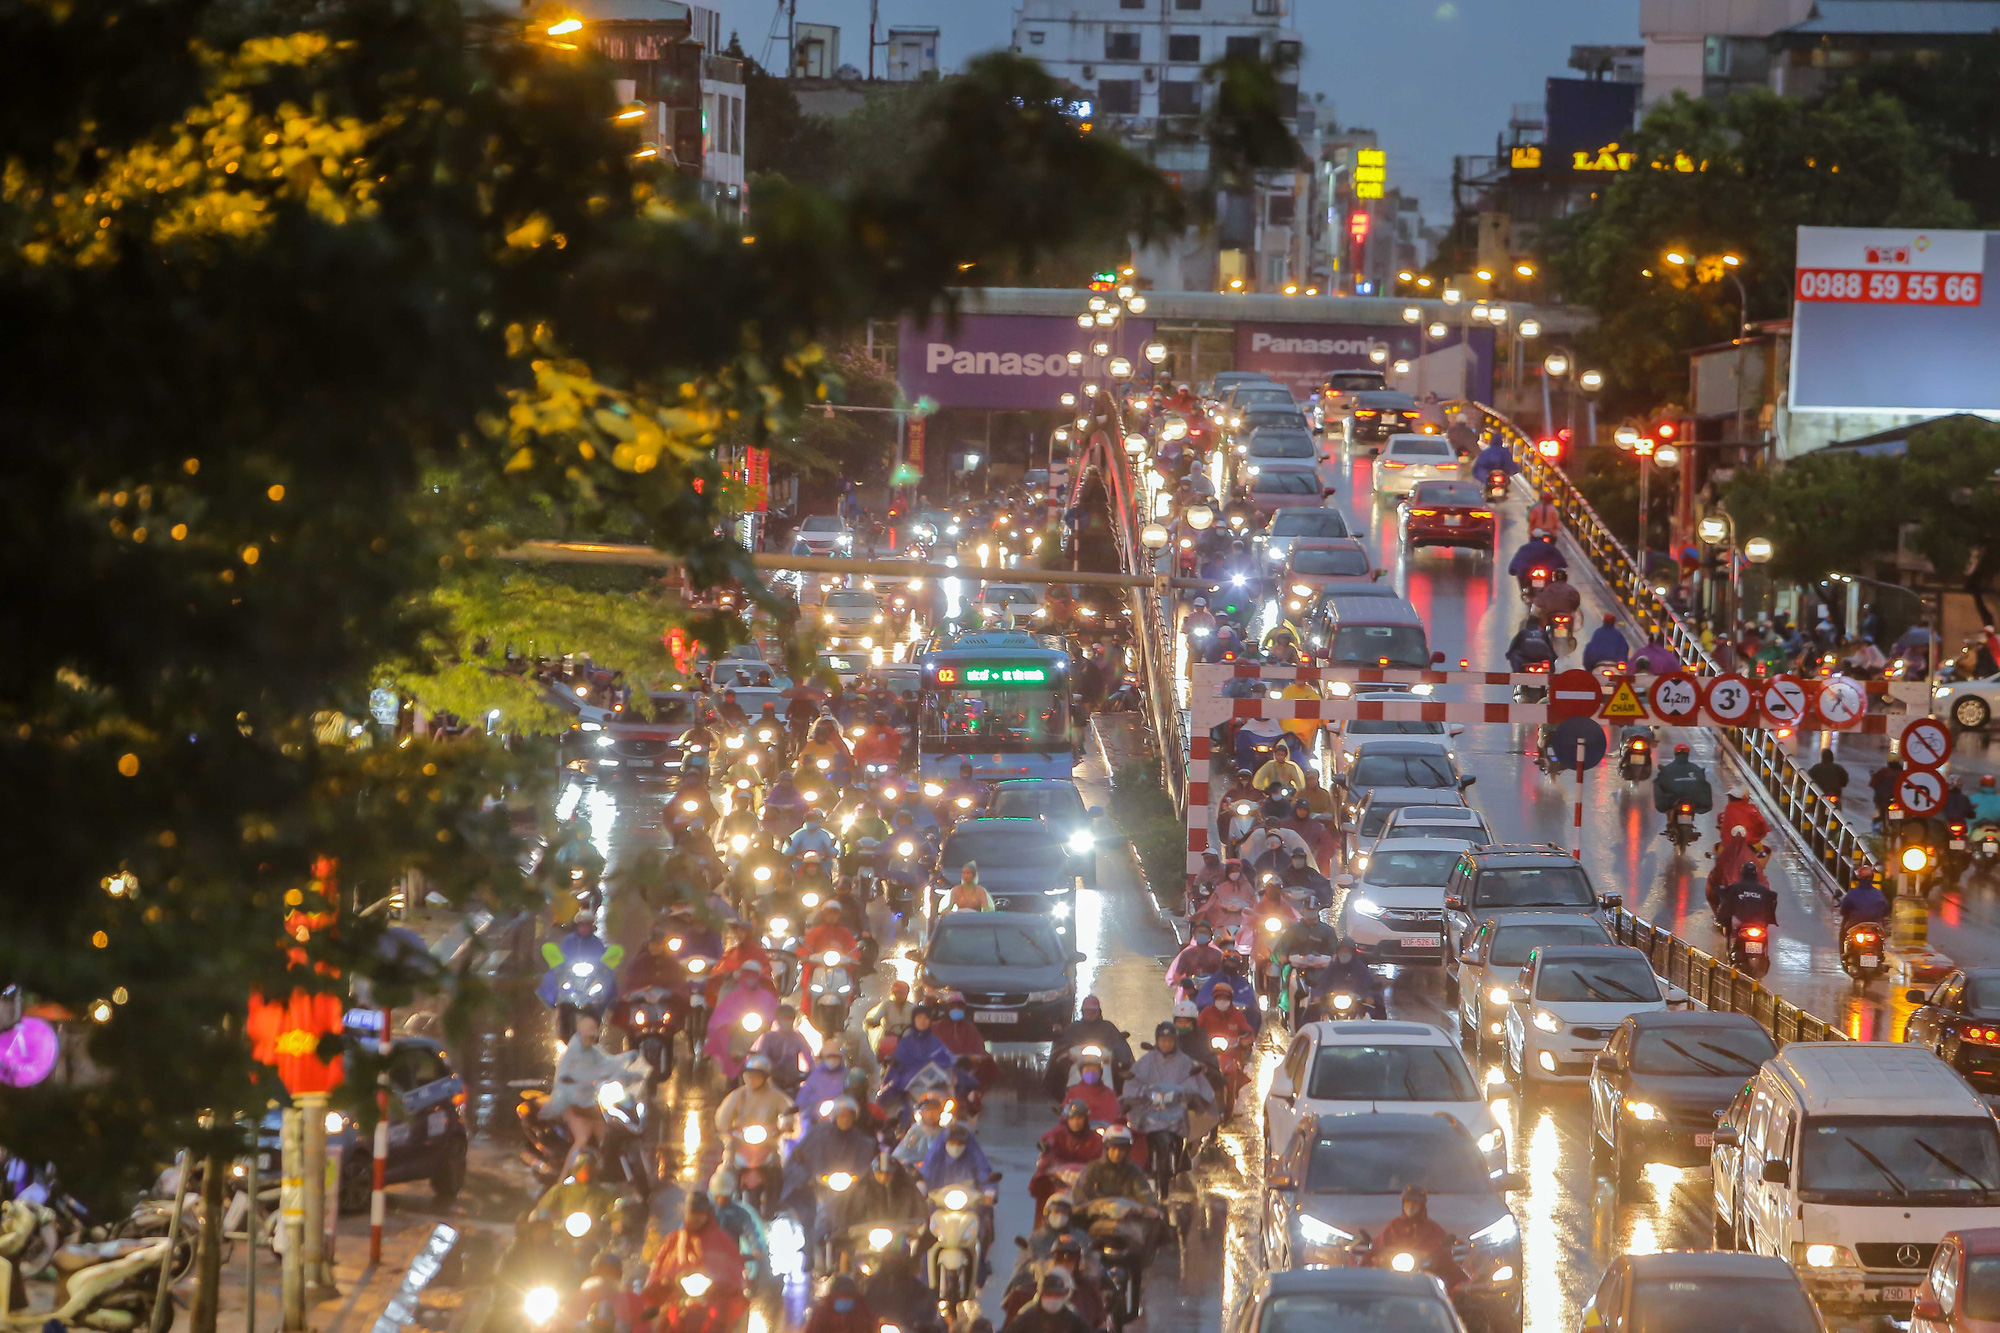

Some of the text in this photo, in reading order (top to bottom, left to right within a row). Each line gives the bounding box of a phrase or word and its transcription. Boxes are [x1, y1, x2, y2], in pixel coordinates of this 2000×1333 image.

[1801, 272, 1976, 302] 0988 59 55 66
[938, 669, 955, 682] 02
